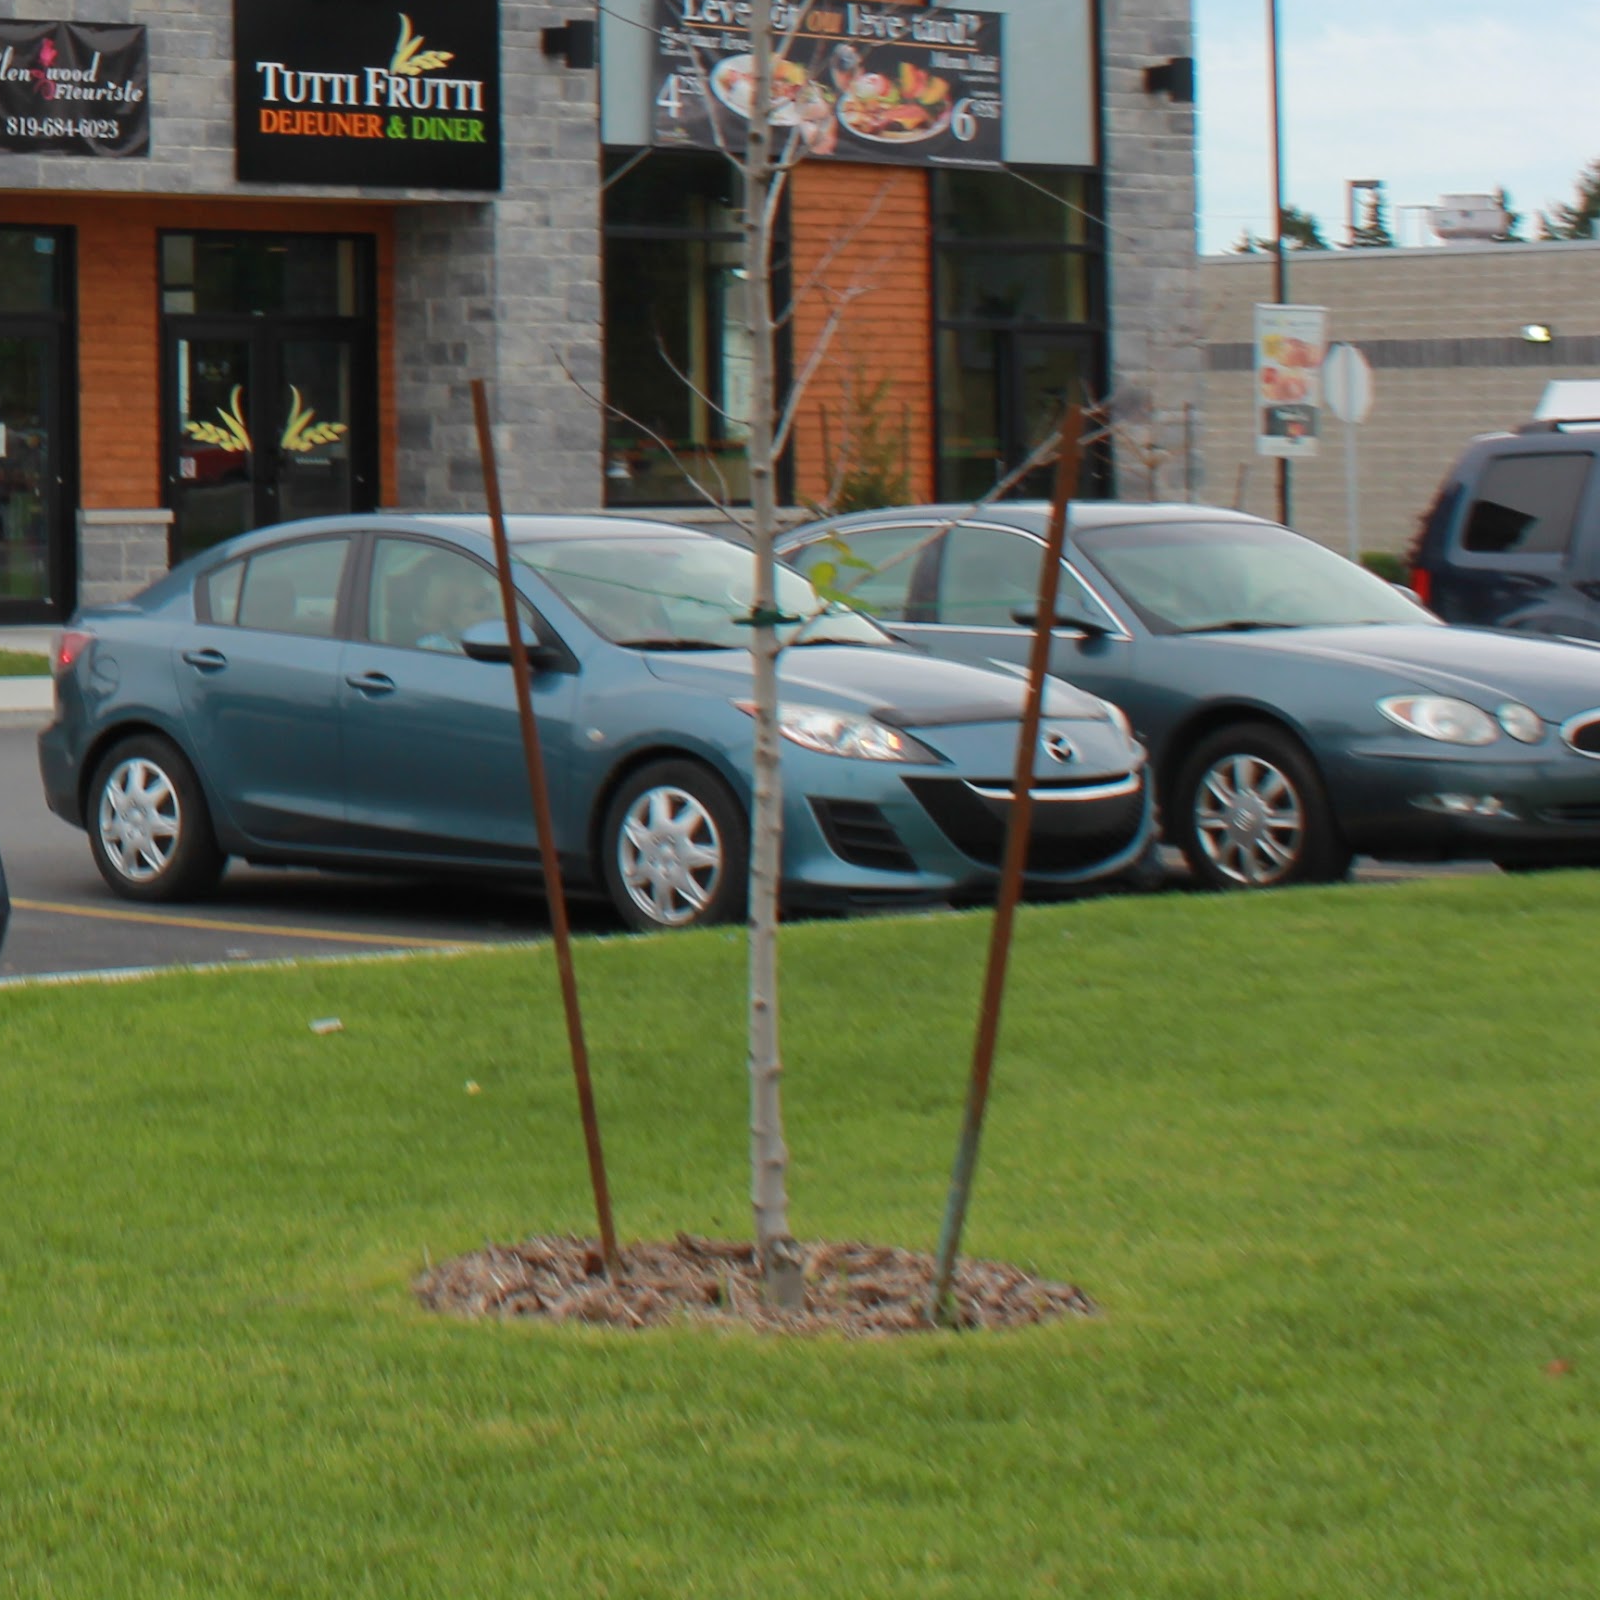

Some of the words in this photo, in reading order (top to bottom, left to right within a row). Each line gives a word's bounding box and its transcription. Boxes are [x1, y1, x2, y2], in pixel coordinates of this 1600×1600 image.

[54, 80, 144, 102] Fleuriste
[256, 61, 360, 107] TUTTI
[363, 66, 485, 112] FRUTTI
[6, 116, 120, 139] 819-684-6023
[260, 108, 385, 139] DEJEUNER
[386, 114, 408, 140] &
[411, 116, 487, 143] DINER
